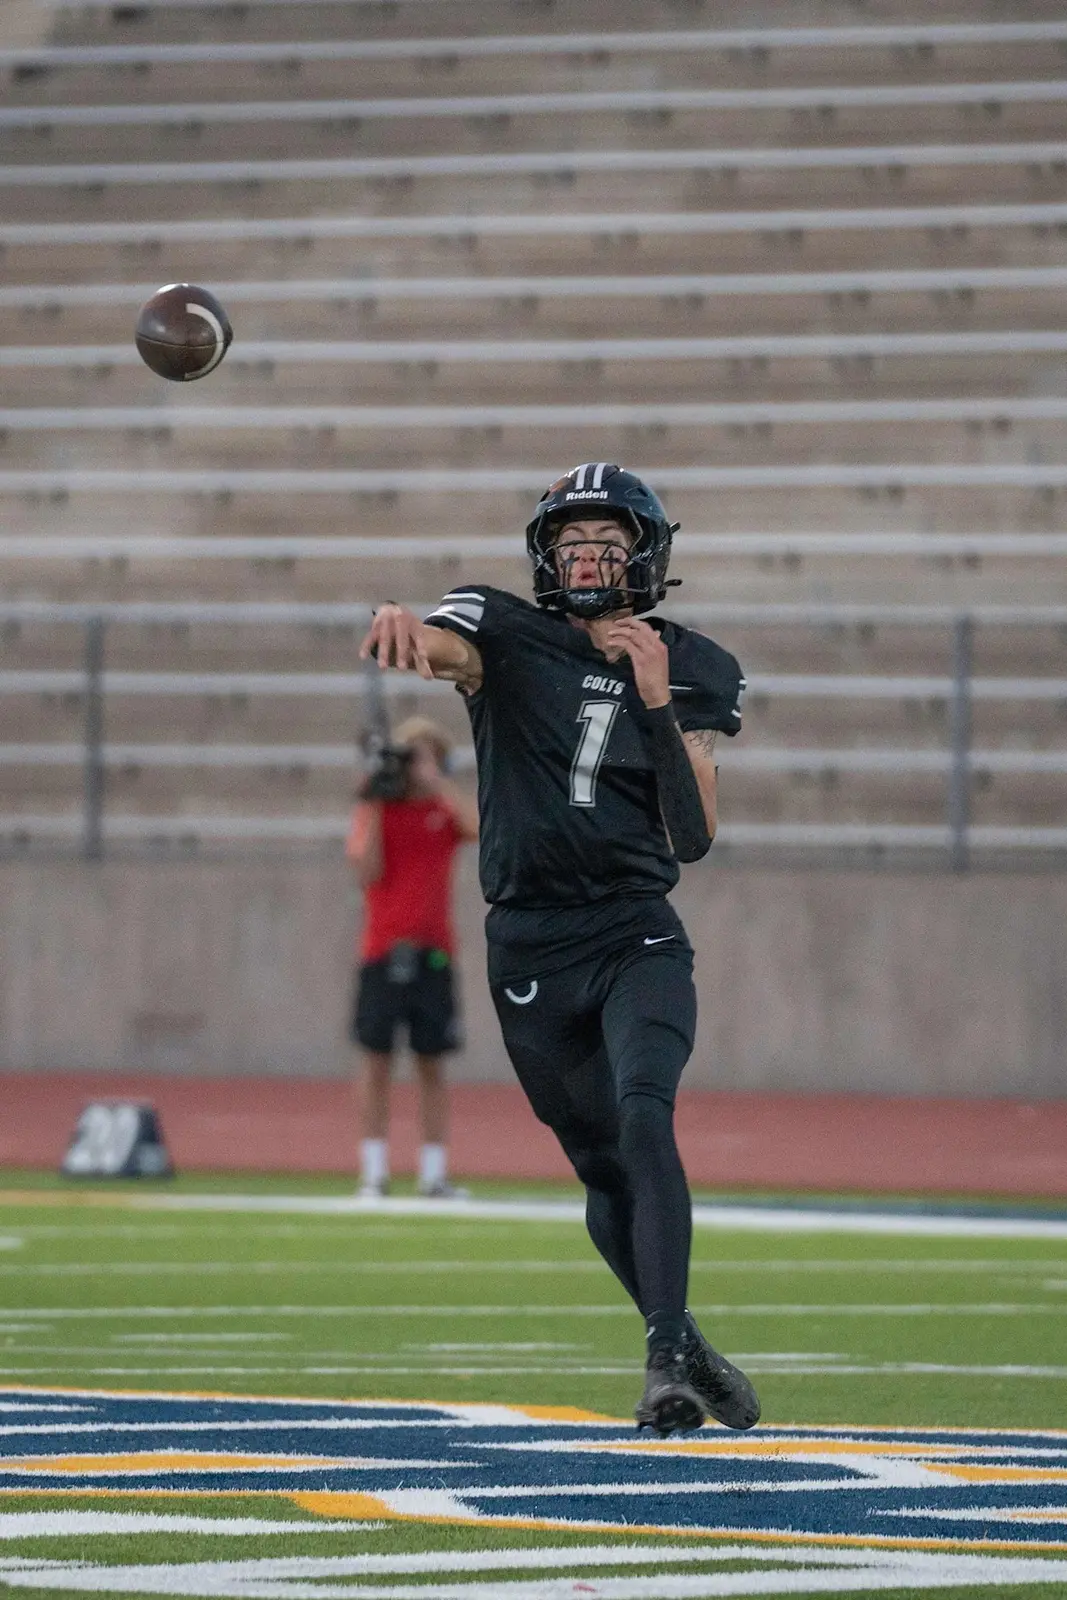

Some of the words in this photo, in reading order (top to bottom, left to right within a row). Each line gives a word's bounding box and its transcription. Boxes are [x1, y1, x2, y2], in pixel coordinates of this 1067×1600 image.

[565, 490, 609, 501] Riddell
[581, 674, 626, 695] COLTS
[568, 699, 621, 807] 1
